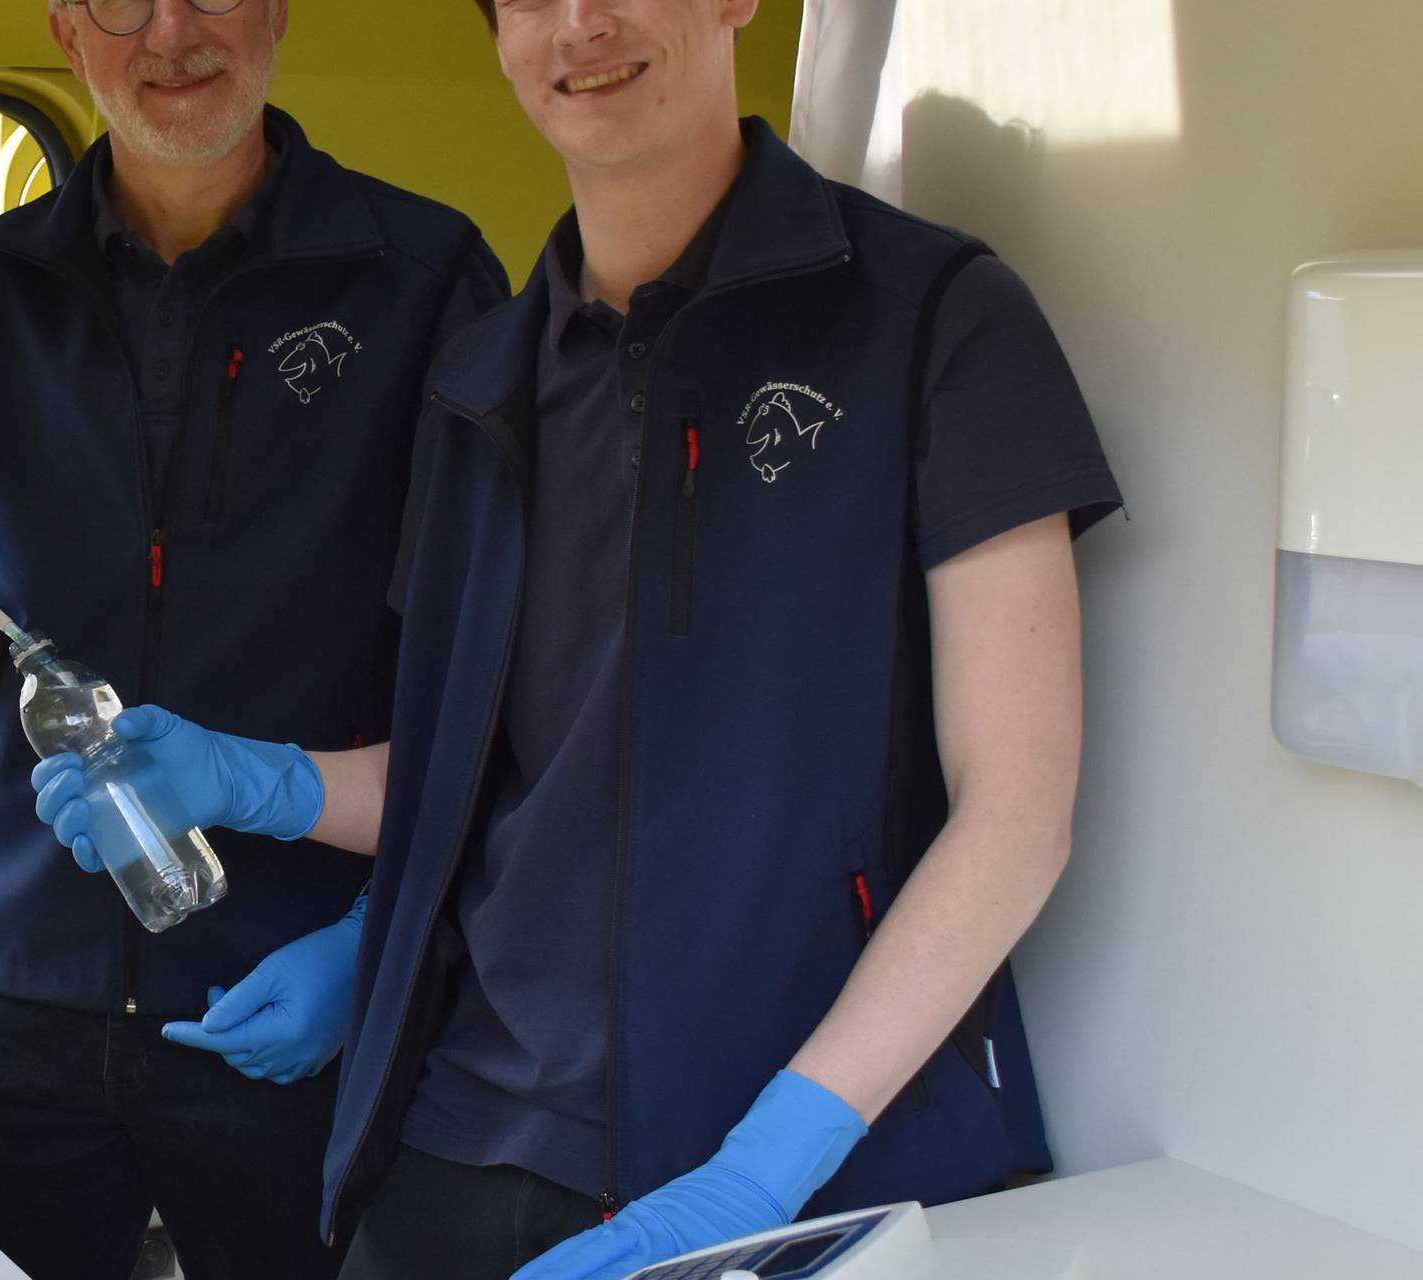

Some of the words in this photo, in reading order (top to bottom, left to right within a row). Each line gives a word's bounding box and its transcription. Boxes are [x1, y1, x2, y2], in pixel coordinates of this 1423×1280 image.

[268, 320, 349, 354] VSR-Gewässerschutz
[354, 342, 363, 353] V.
[736, 381, 826, 425] VSR-Gewässerschutz
[825, 401, 833, 411] e.
[833, 408, 844, 421] V.
